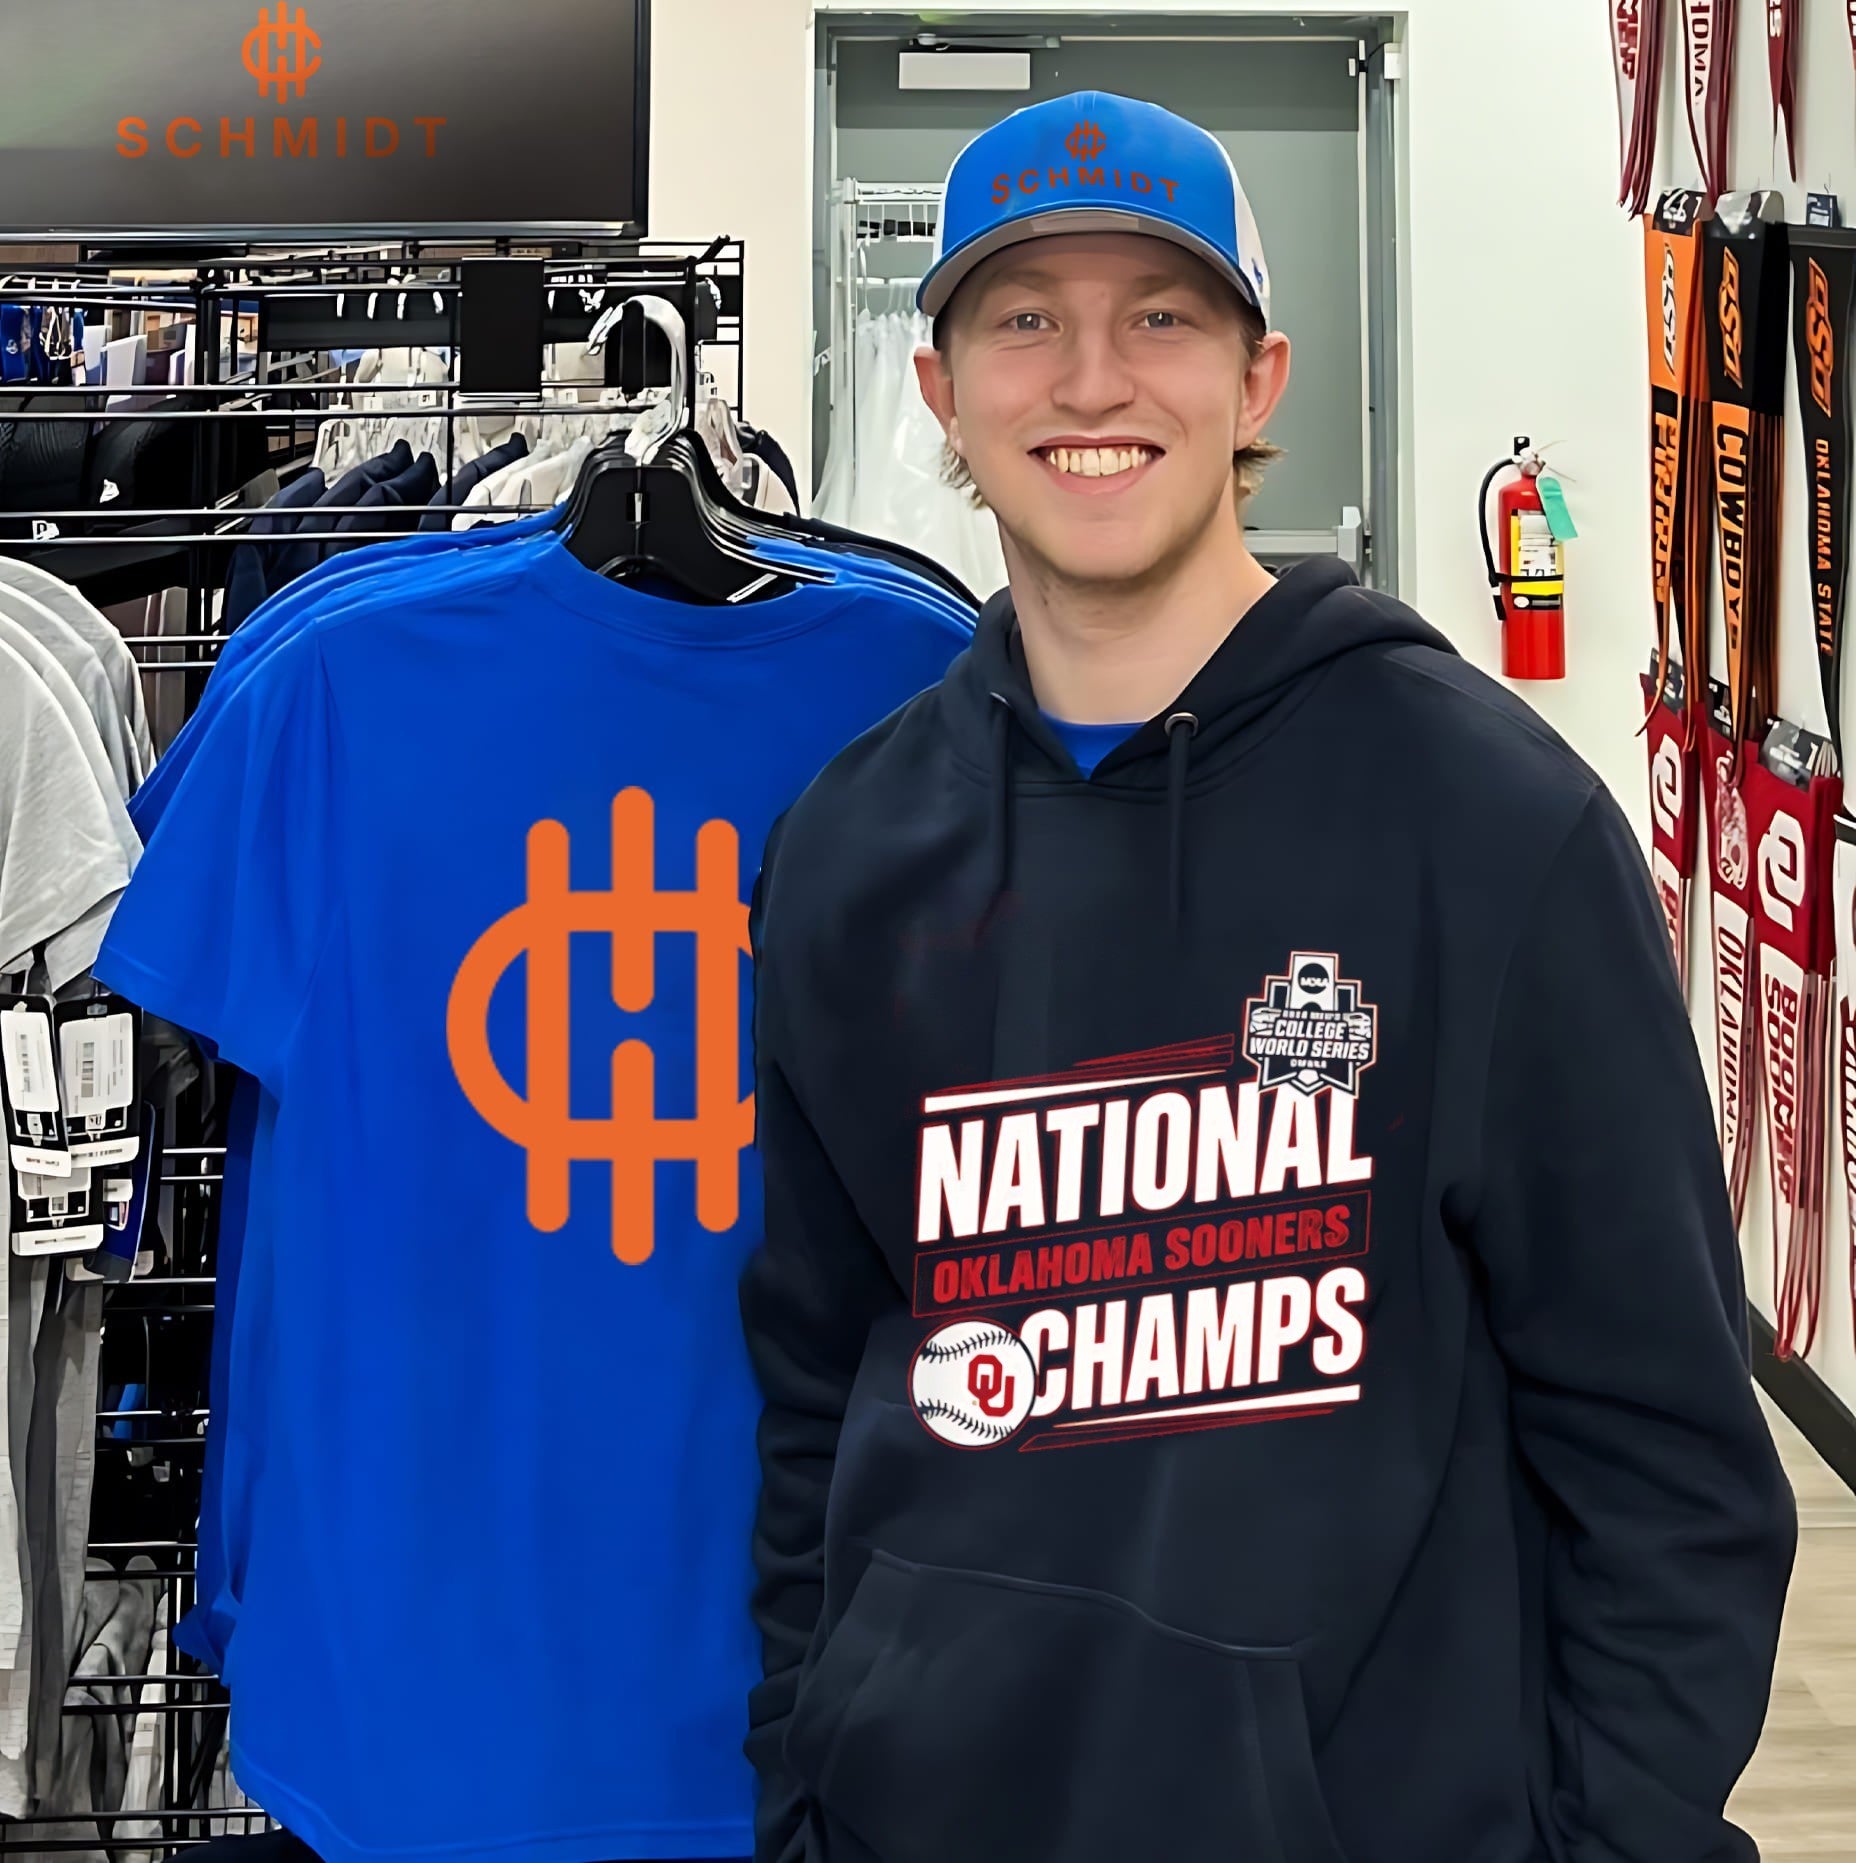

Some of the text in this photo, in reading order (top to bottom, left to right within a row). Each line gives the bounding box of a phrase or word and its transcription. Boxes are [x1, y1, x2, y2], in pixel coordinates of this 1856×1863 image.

[115, 116, 447, 158] SCHMIDT
[991, 166, 1179, 204] SCHMIDT
[1816, 438, 1831, 569] OKLAHOMA
[1250, 1037, 1370, 1060] WORLD SERIES
[1275, 1019, 1347, 1040] COLLEGE
[917, 1083, 1373, 1243] NATIONAL
[932, 1204, 1351, 1304] OKLAHOMA SOONERS
[1020, 1266, 1366, 1418] CHAMPS
